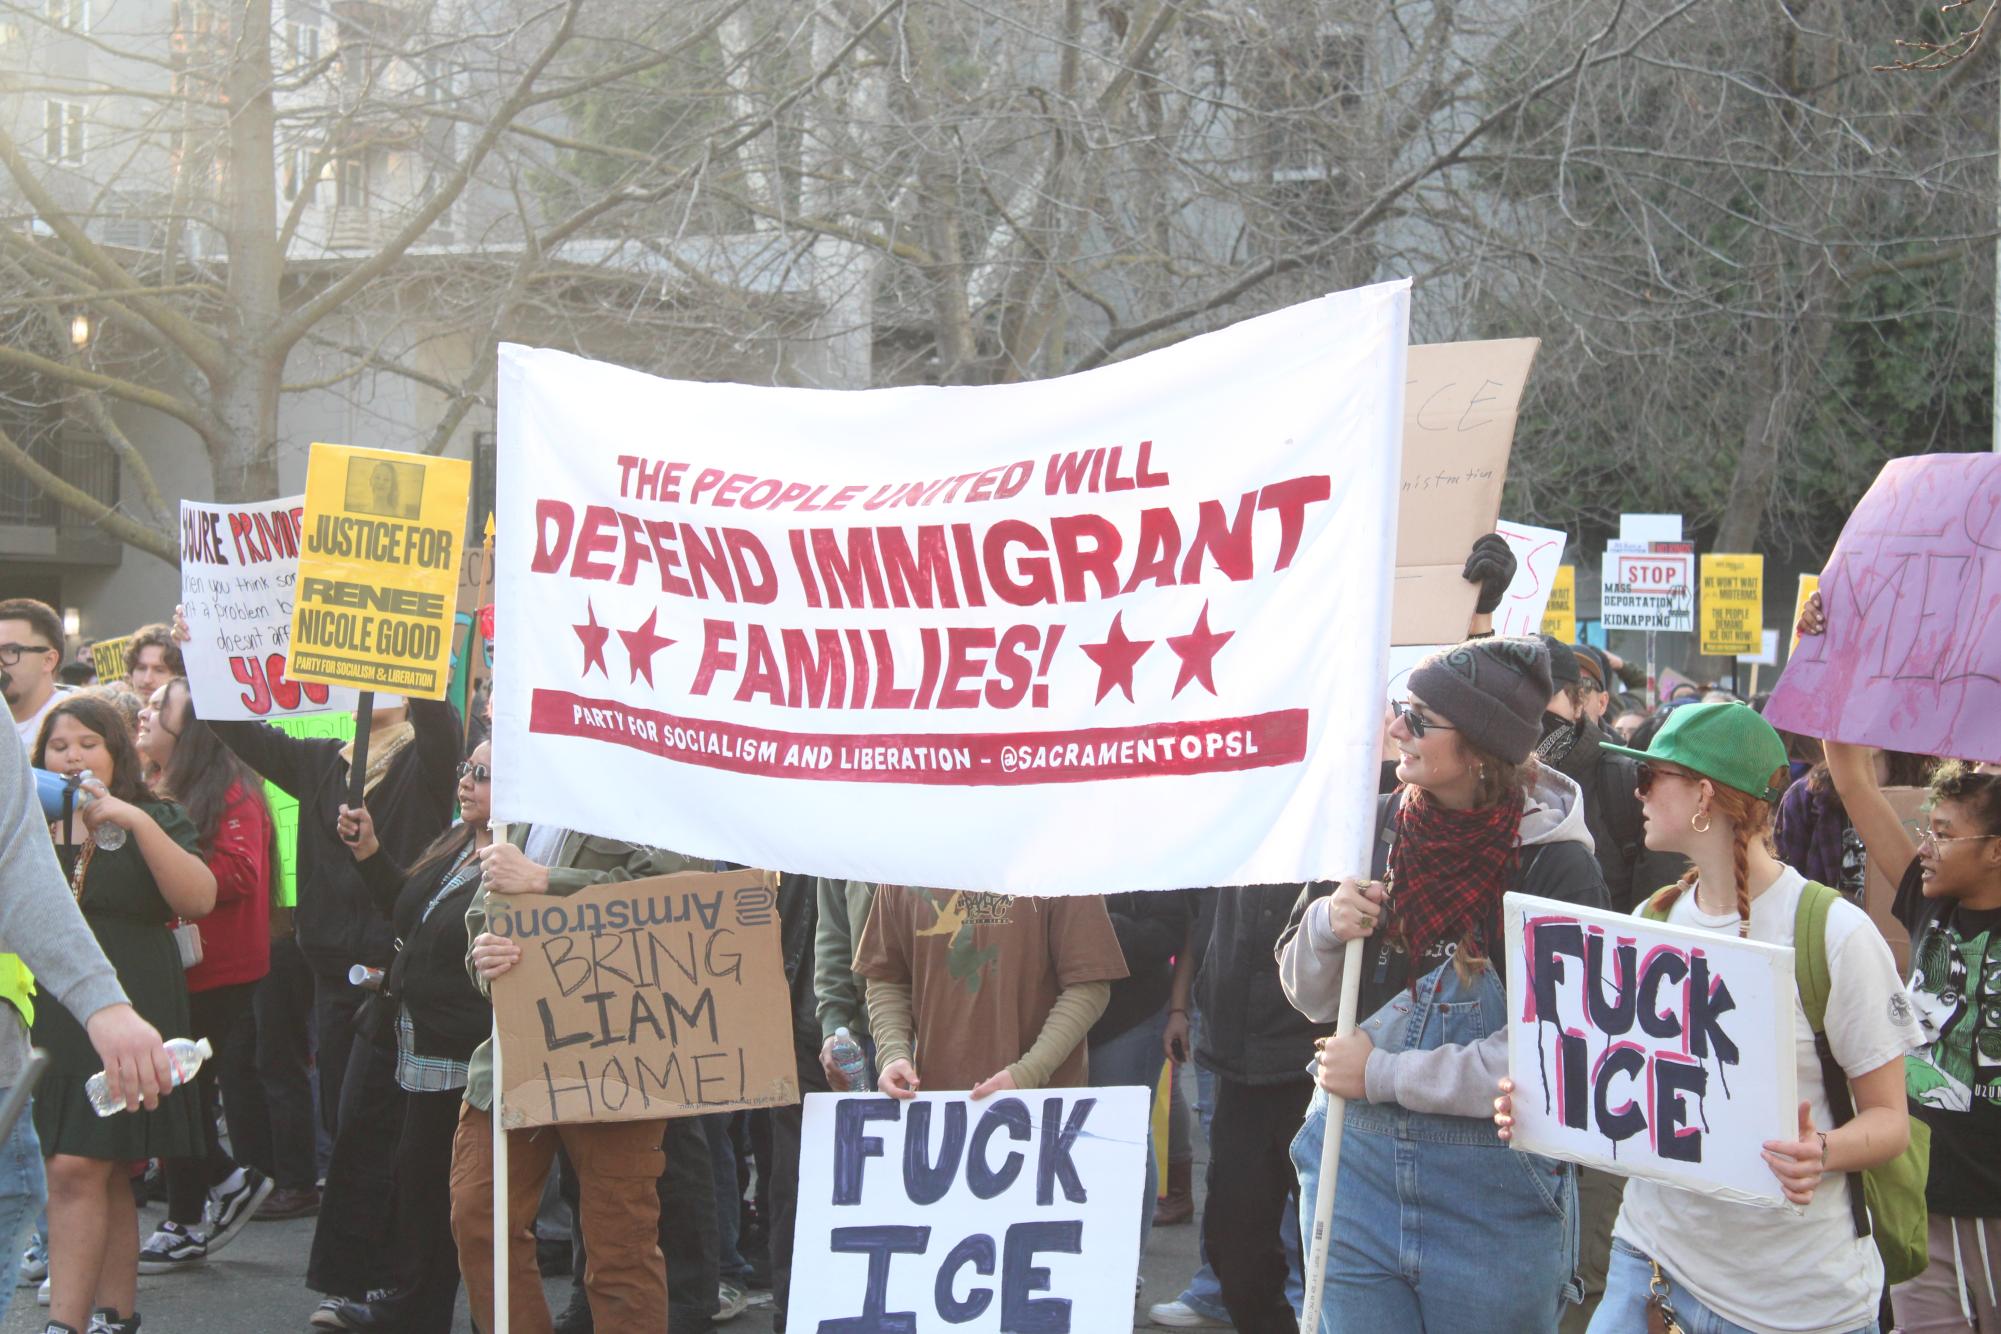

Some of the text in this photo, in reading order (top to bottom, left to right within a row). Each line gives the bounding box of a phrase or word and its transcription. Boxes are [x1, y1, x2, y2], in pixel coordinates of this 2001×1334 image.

[1406, 379, 1503, 432] CE
[617, 440, 1170, 512] THE PEOPLE UNITED WILL
[308, 514, 403, 563] JUSTICE
[403, 526, 453, 570] FOR
[531, 475, 1331, 608] DEFEND IMMIGRANT
[209, 577, 230, 602] you
[237, 576, 269, 592] think
[302, 577, 445, 620] RENEE
[1604, 583, 1632, 593] MASS
[1604, 595, 1673, 608] DEPORTATION
[1628, 566, 1676, 584] STOP
[214, 600, 270, 621] problem
[297, 608, 441, 661] NICOLE GOOD
[1604, 614, 1671, 627] KIDNAPPING
[295, 655, 433, 688] PARTY FOR SOCIALISM & LIBERATION
[689, 618, 1067, 710] FAMILIES!
[573, 704, 625, 728] PARTY
[629, 716, 658, 742] FOR
[664, 725, 777, 764] SOCIALISM
[783, 748, 833, 768] AND
[841, 747, 970, 770] LIBERATION
[1001, 731, 1258, 773] @SACRAMENTOPSL
[489, 890, 724, 939] Armstrong
[541, 928, 741, 997] BRING
[1522, 916, 1739, 1065] FUCK
[536, 988, 719, 1051] LIAM
[543, 1047, 745, 1121] HOME!
[1555, 1027, 1709, 1163] ICE
[832, 1097, 1098, 1206] FUCK
[816, 1219, 1083, 1334] ICE
